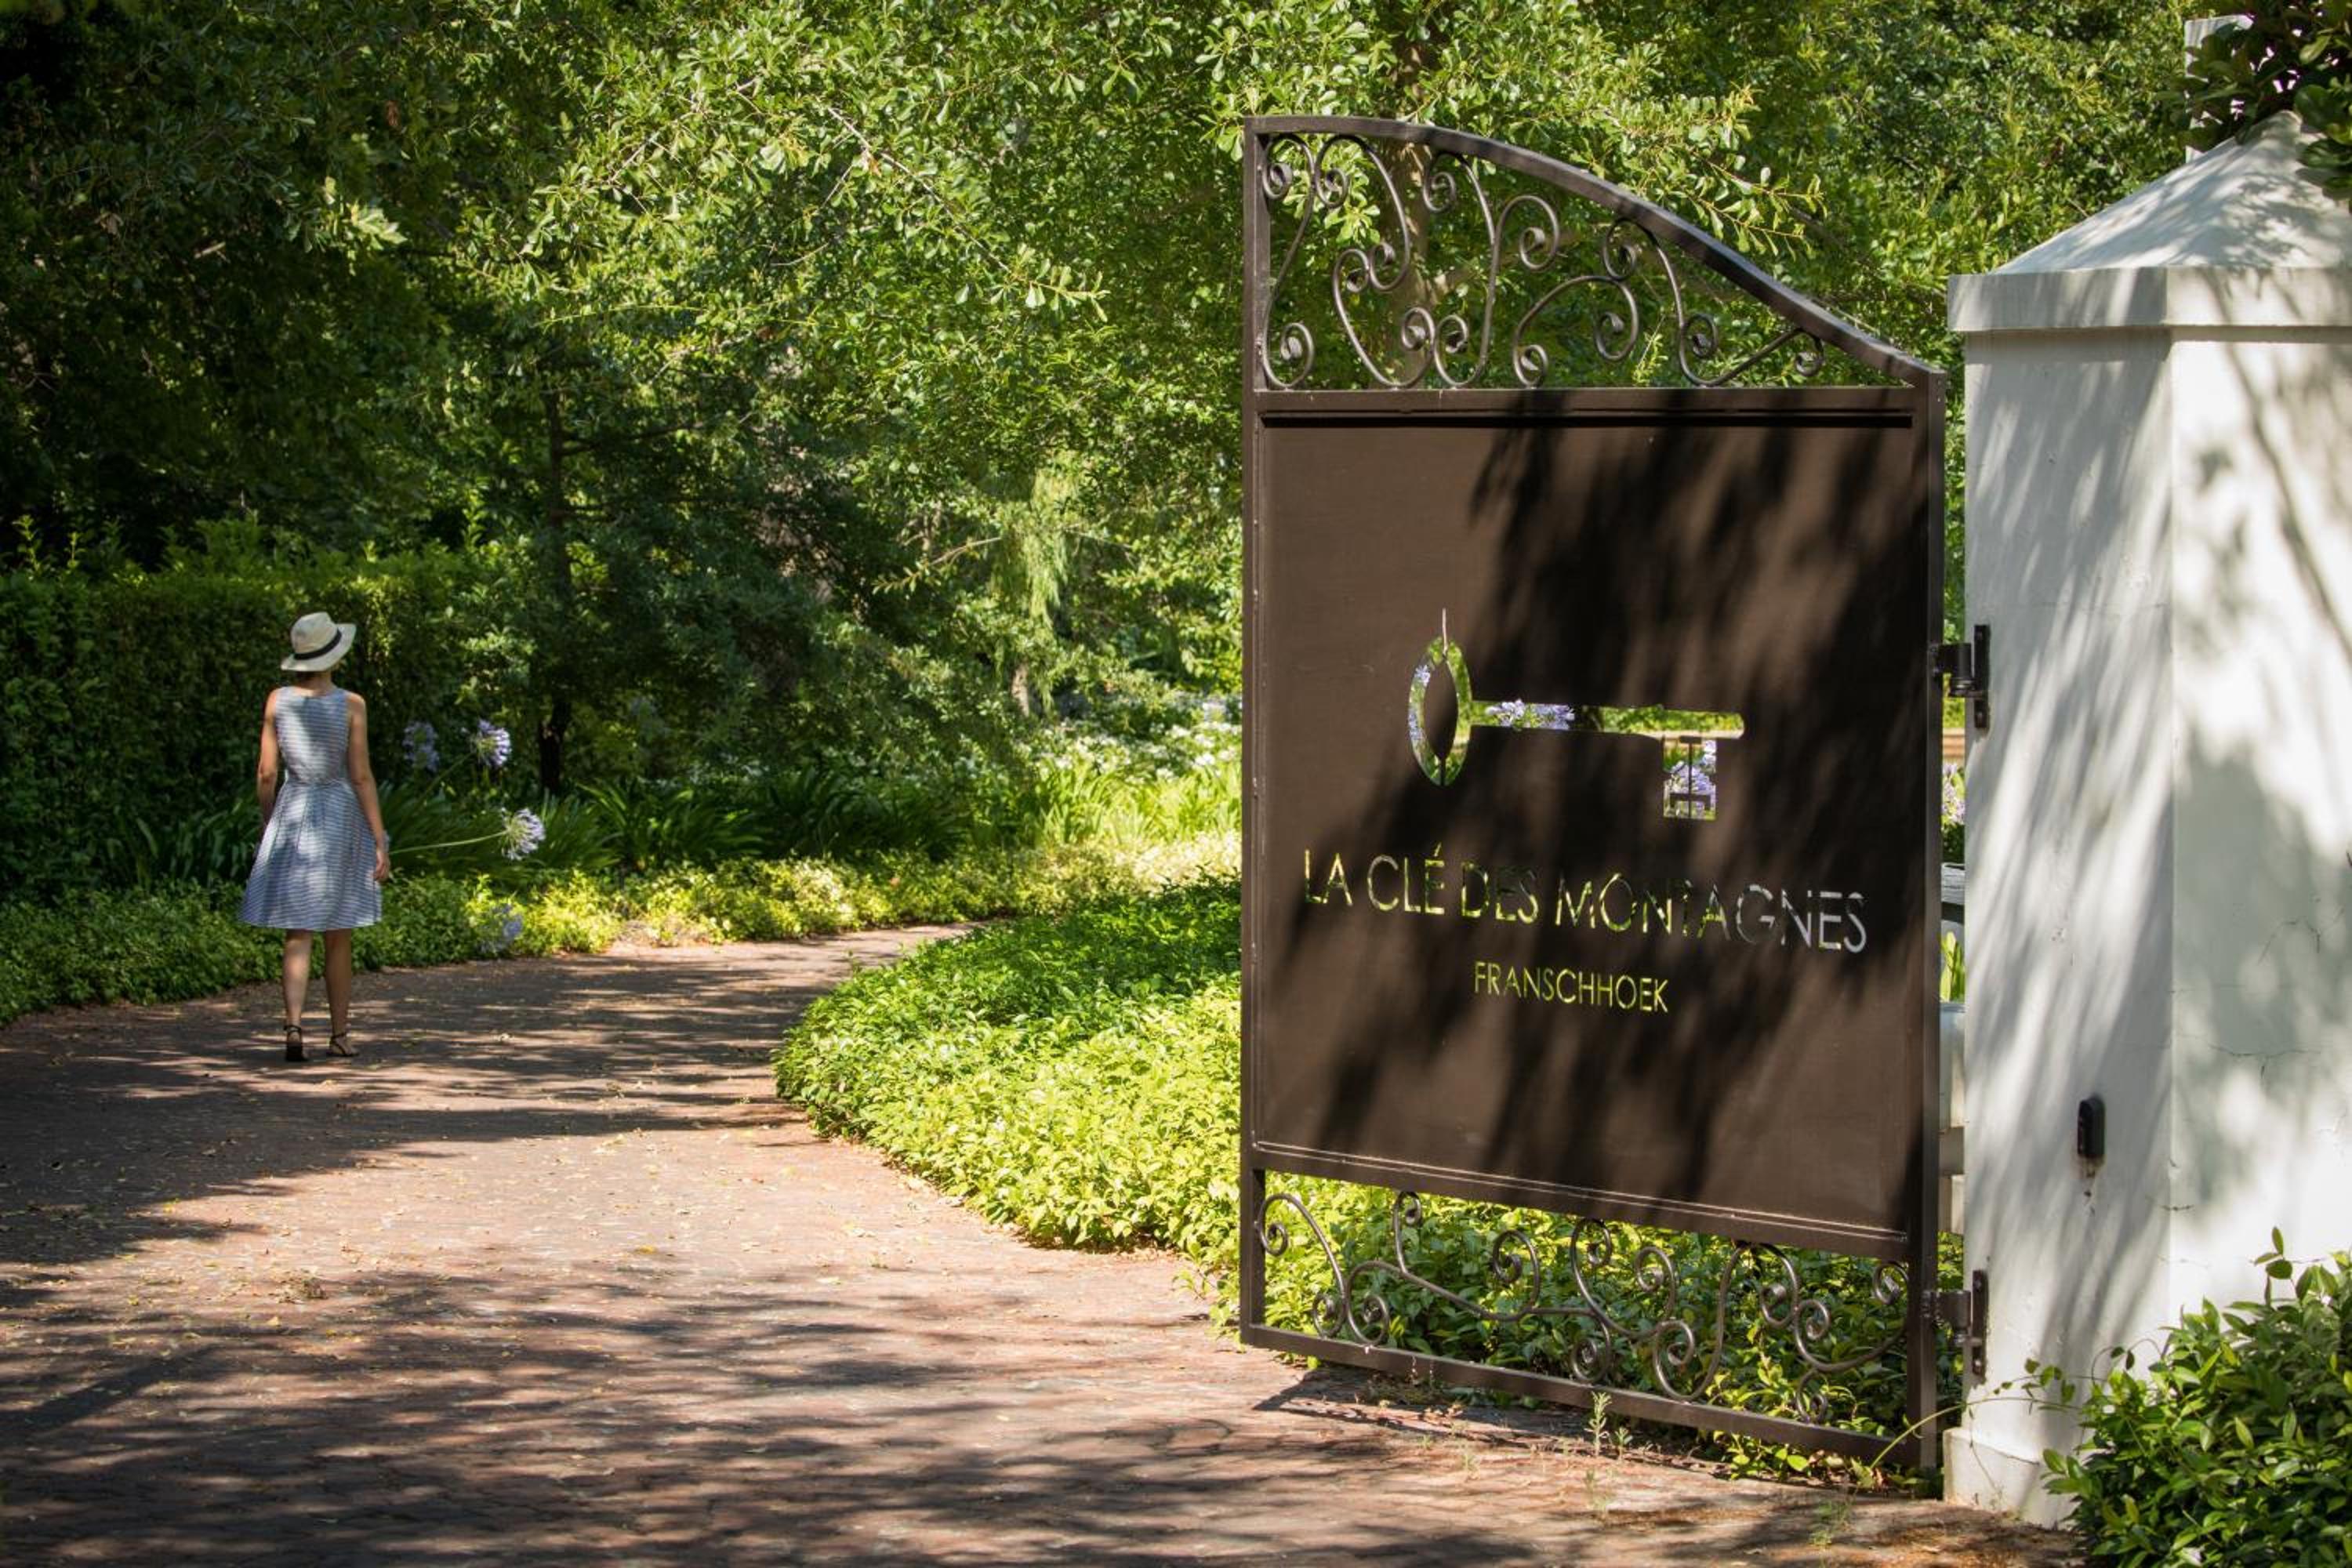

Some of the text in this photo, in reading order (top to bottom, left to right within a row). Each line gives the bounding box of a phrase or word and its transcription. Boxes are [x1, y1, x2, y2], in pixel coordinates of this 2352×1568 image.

[1305, 842, 1867, 954] LA CLÉ DES MONTAGNES
[1474, 960, 1669, 1013] FRANSCHHOEK
